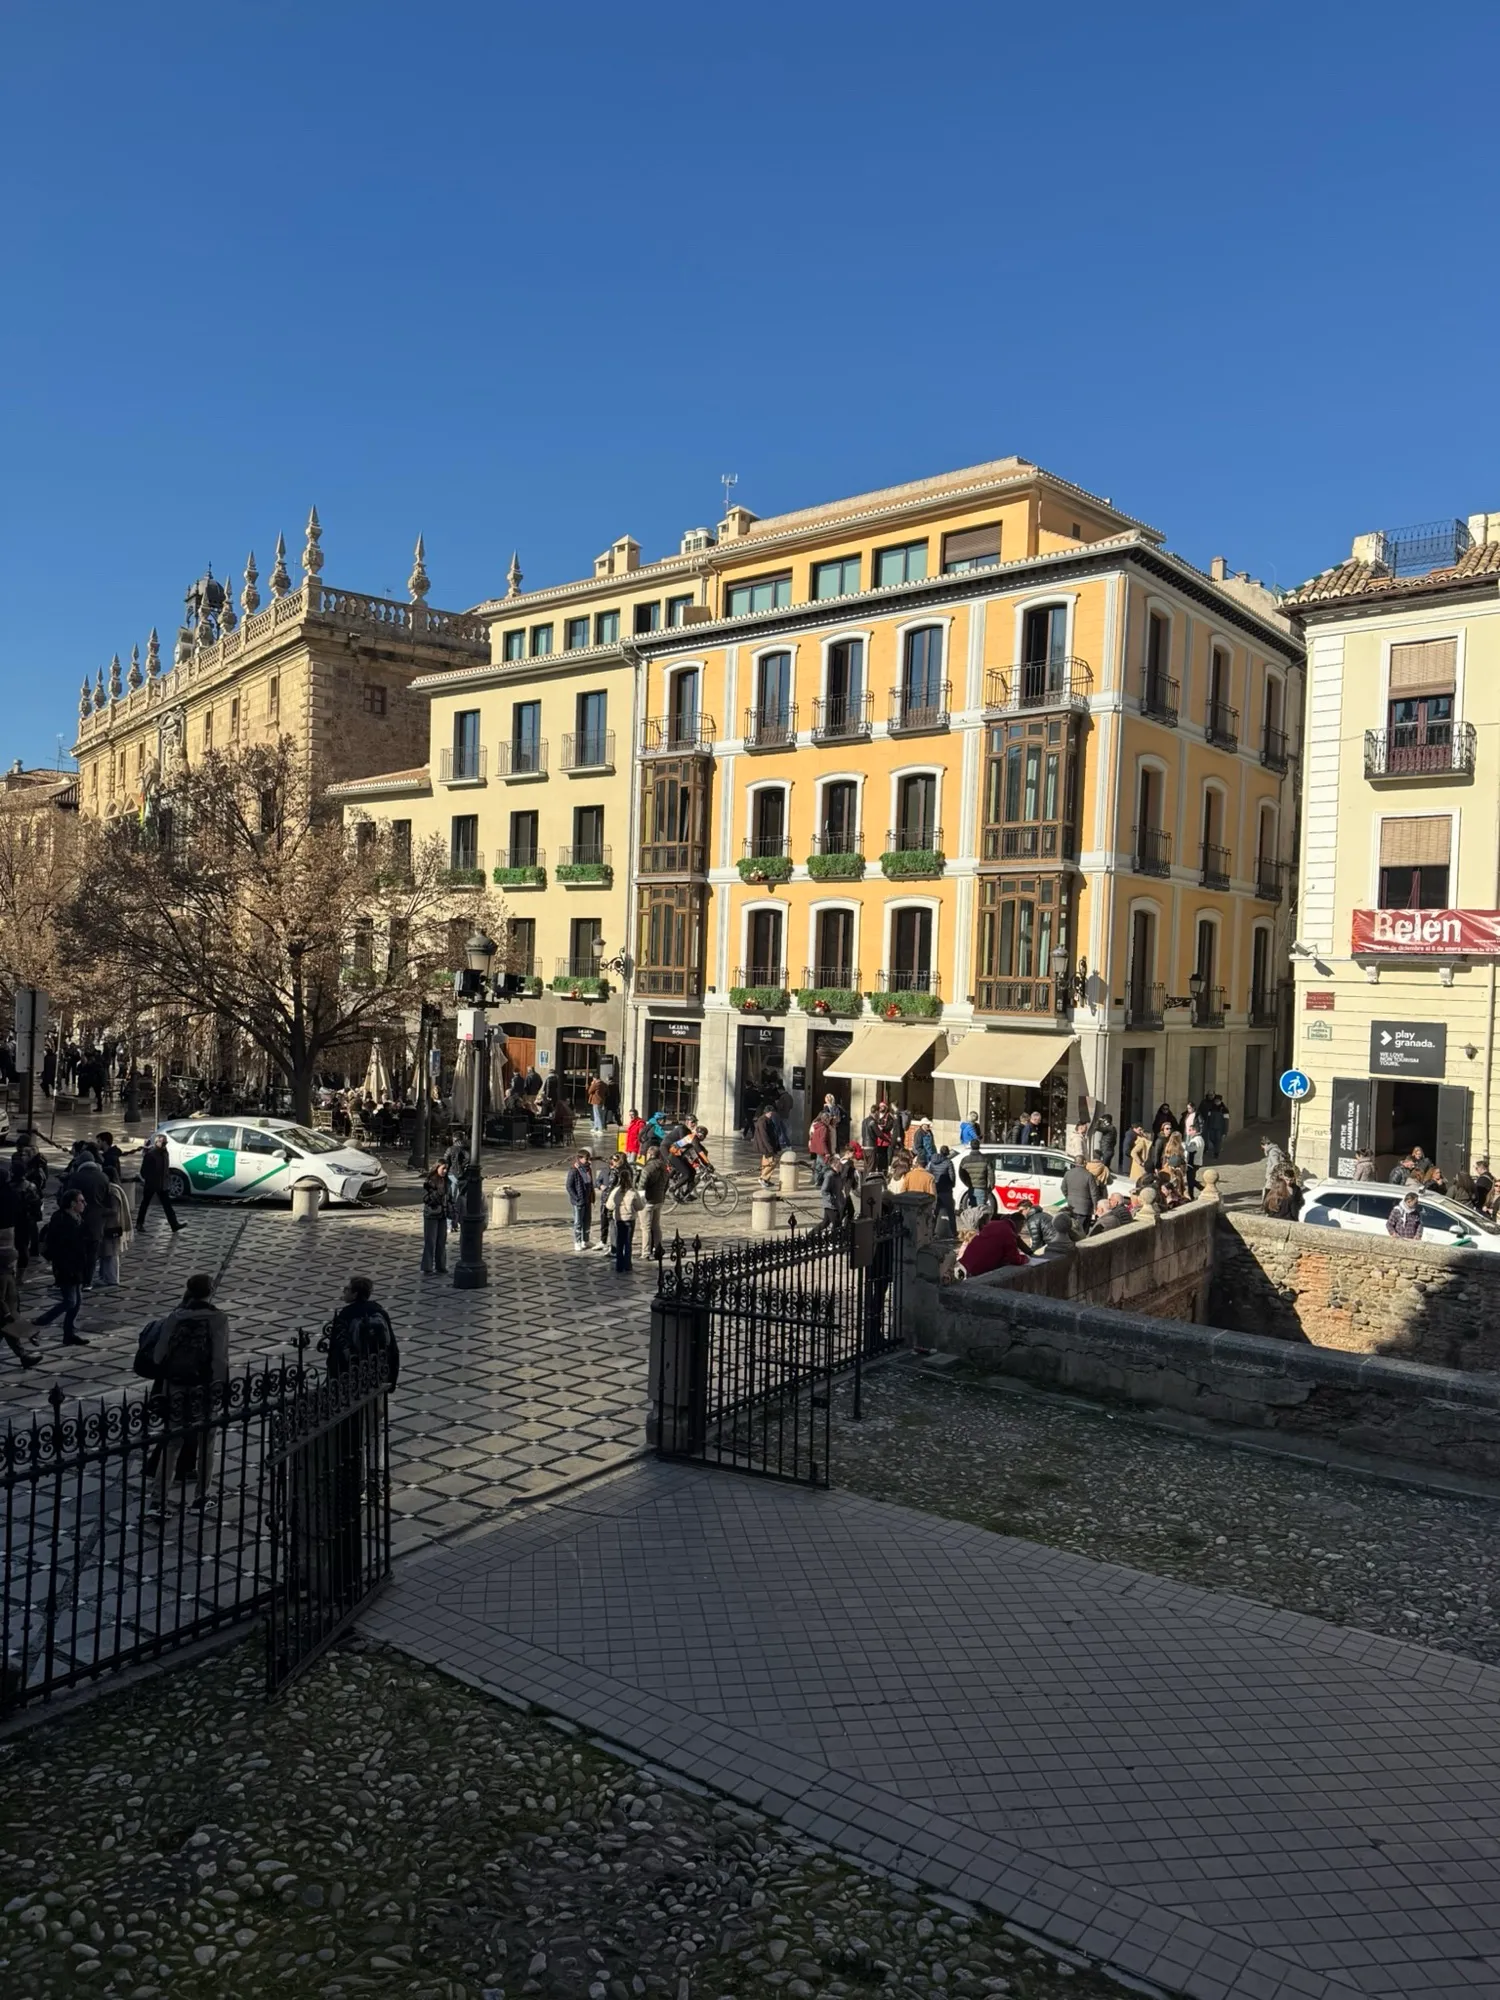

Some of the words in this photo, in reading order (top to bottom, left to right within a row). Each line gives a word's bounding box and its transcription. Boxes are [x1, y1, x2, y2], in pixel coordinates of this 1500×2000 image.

[1374, 911, 1461, 943] Belén
[1394, 1039, 1436, 1048] granada.
[1395, 1029, 1415, 1040] play
[1346, 1118, 1354, 1150] ALHAMBRA
